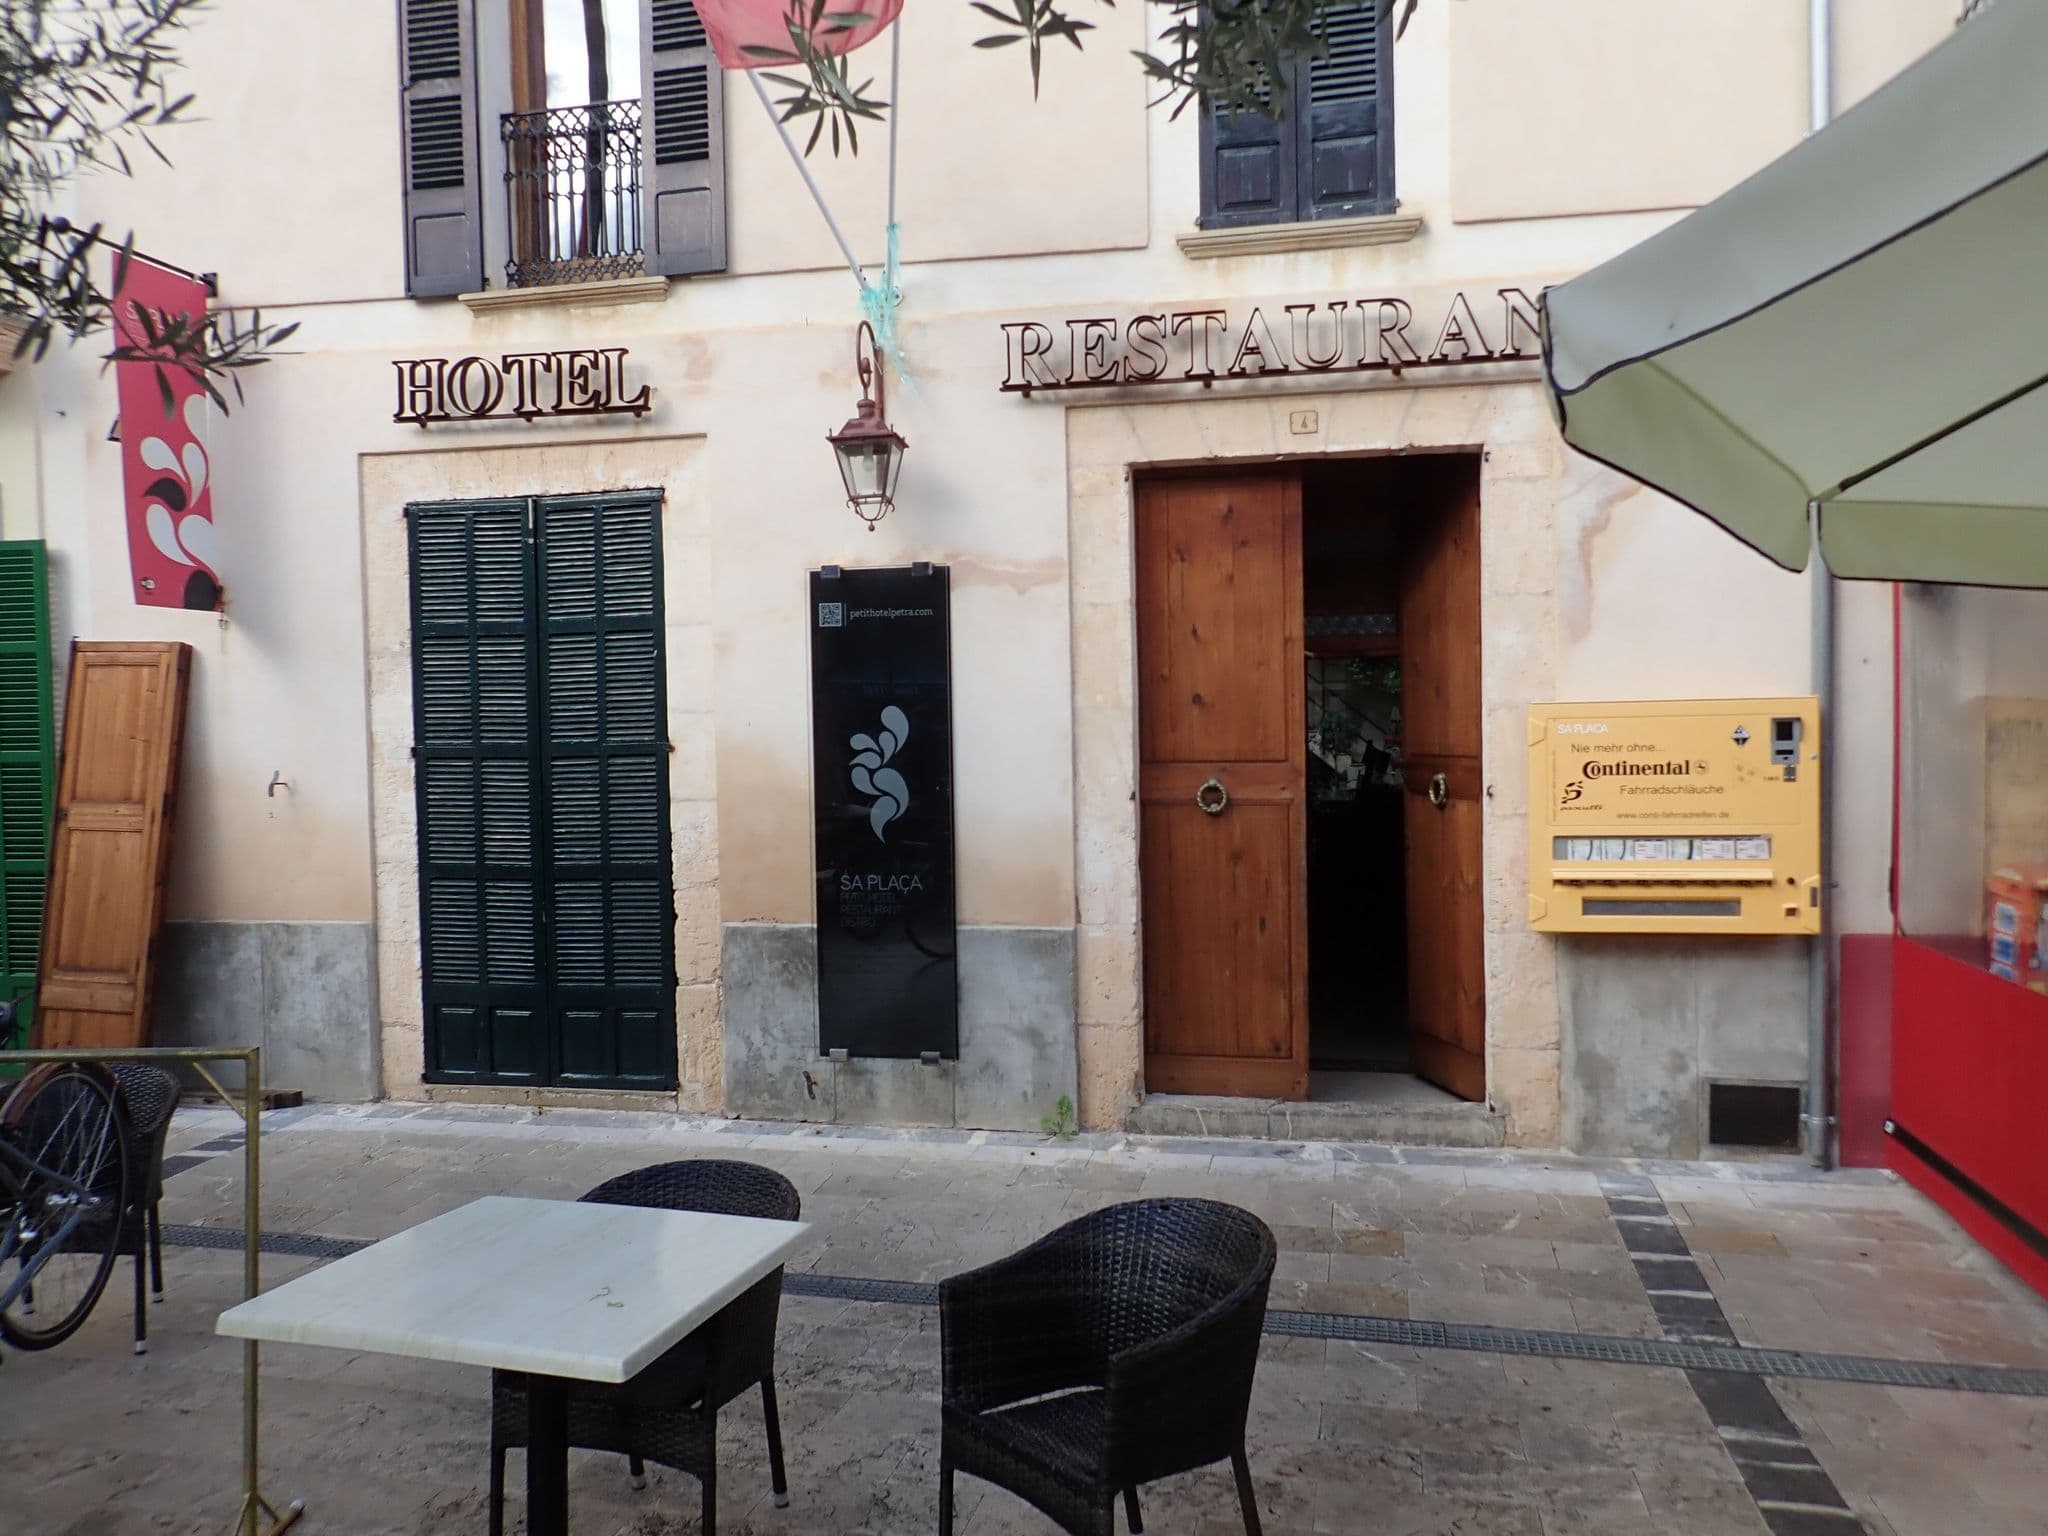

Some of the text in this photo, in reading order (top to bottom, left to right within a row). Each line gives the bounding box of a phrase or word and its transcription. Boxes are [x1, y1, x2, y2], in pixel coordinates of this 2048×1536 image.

[392, 348, 652, 421] HOTEL
[849, 608, 933, 620] petithotelpetra.com
[1570, 743, 1590, 753] Nie
[1593, 743, 1623, 753] mehr
[1582, 759, 1691, 780] Continental
[1619, 784, 1725, 795] Fahrradschläuche
[840, 874, 923, 895] SA PLAÇA
